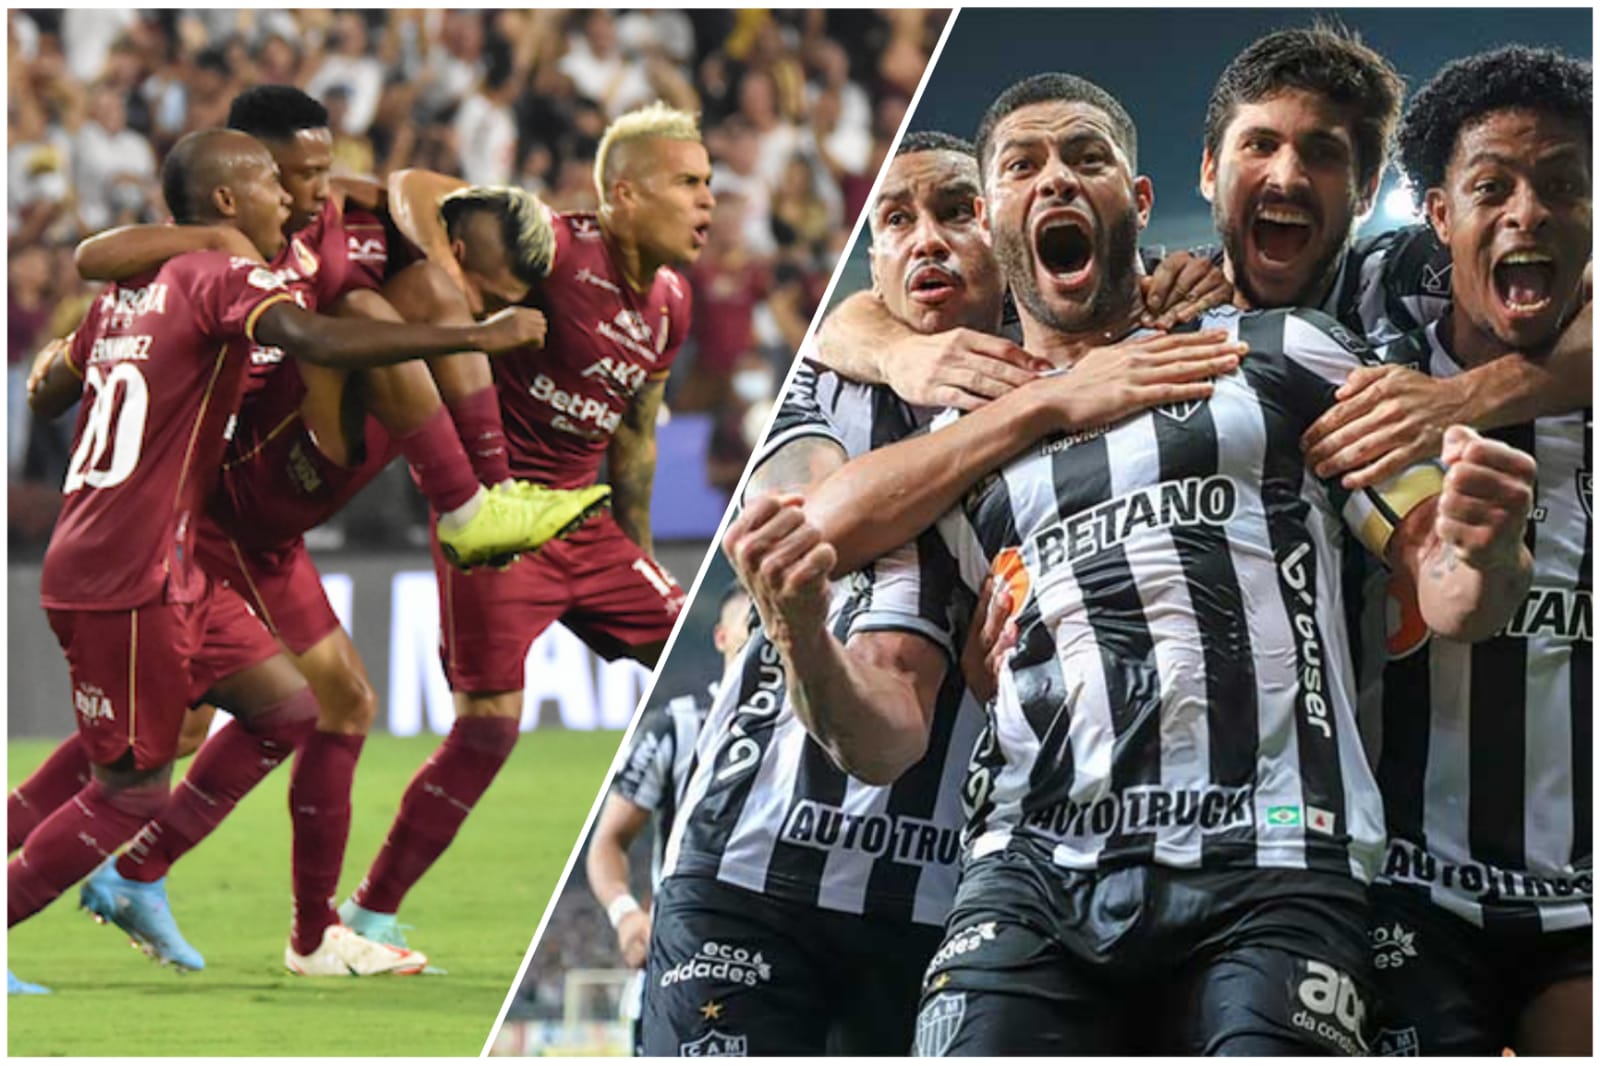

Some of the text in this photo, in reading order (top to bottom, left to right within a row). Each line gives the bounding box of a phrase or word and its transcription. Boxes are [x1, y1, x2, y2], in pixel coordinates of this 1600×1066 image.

[62, 361, 149, 494] 20
[529, 374, 622, 434] BetPla
[1034, 475, 1238, 579] BETANO
[1511, 590, 1593, 638] TAN
[738, 642, 785, 716] bus
[788, 805, 961, 866] AUTO TRU
[1127, 788, 1249, 830] TRUCK
[703, 941, 750, 962] eco
[1291, 1010, 1316, 1032] da
